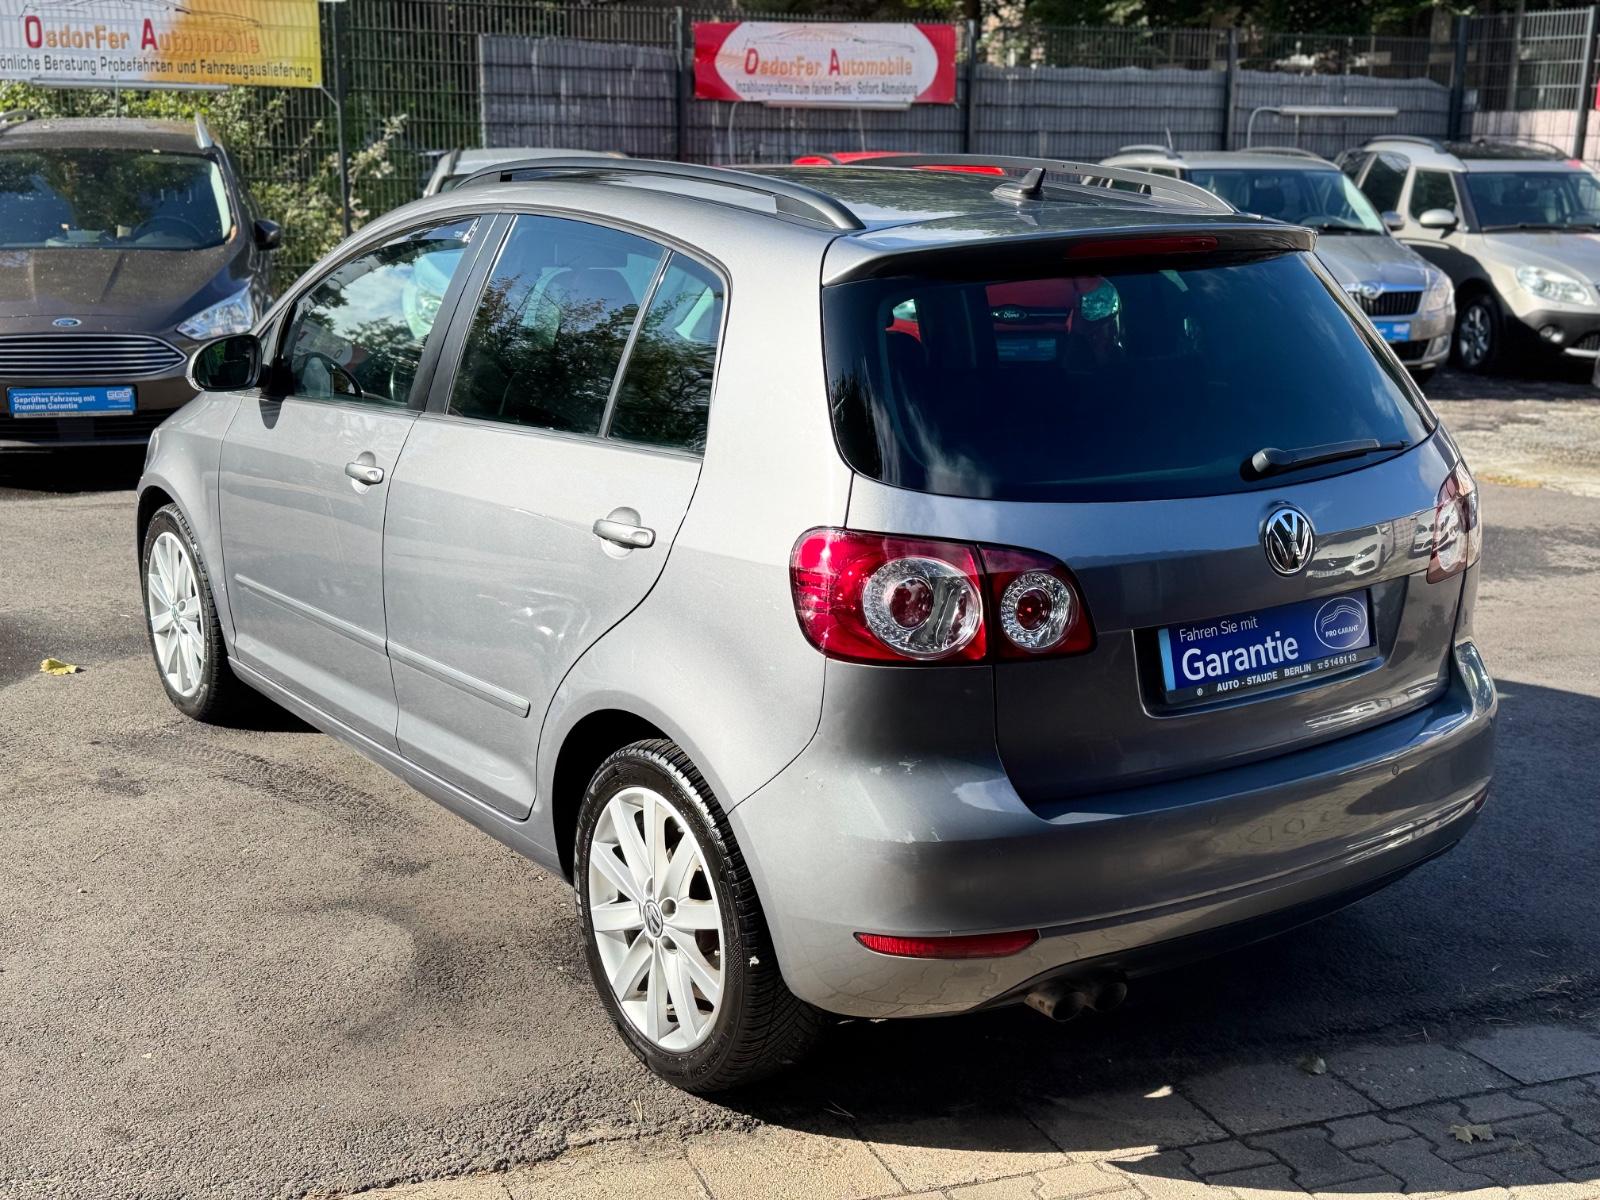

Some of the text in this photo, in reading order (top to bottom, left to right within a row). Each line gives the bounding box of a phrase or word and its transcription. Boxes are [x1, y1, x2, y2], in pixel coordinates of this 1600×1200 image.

[141, 18, 260, 54] Automobile
[44, 54, 97, 75] Beratung
[100, 56, 173, 73] Probefahrten
[177, 59, 197, 74] und
[200, 59, 312, 82] Fahrzeugauslieferung
[829, 48, 913, 76] Automobile
[14, 395, 49, 404] Geprüftes
[50, 394, 82, 404] Fahrzeug
[83, 394, 96, 402] mit
[47, 402, 78, 410] Garantie
[1180, 616, 1258, 642] Fahren Sie mit
[1182, 630, 1299, 681] Garantie
[1216, 679, 1240, 692] AUTO
[1246, 671, 1278, 685] STAUDE
[1284, 663, 1312, 677] BERLIN
